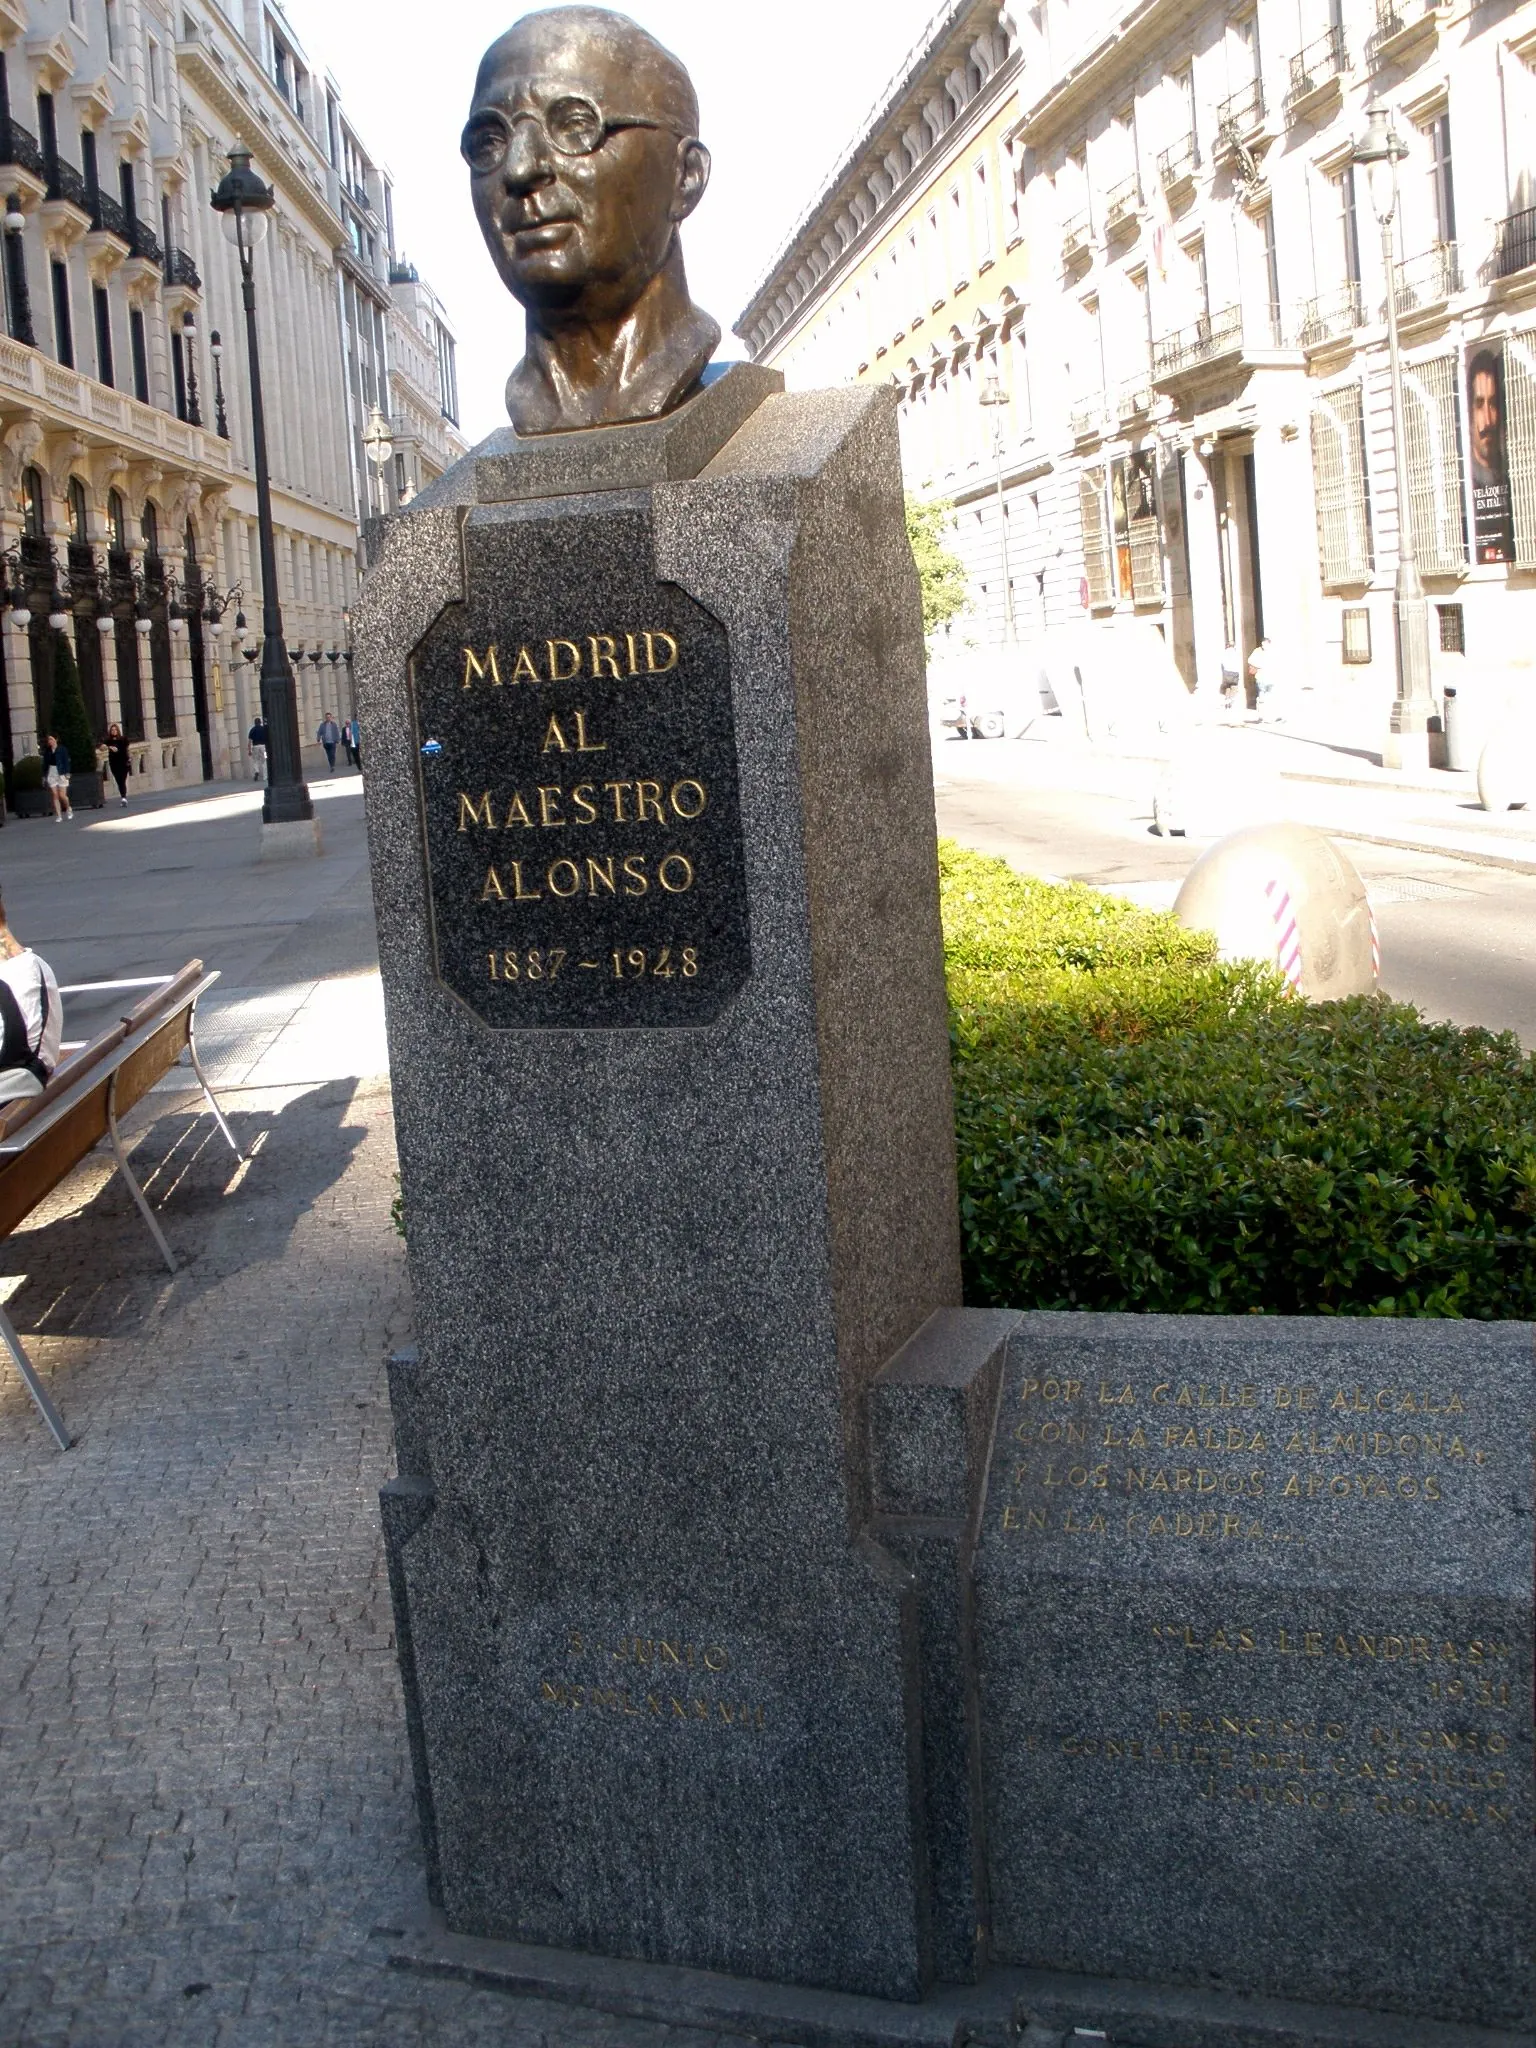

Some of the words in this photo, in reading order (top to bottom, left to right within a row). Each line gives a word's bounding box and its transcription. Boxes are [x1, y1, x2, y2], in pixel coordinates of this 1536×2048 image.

[462, 629, 680, 688] MADRID
[542, 711, 606, 753] AL
[457, 780, 707, 832] MAESTRO
[481, 855, 693, 901] ALONSO
[488, 949, 566, 981] 1887
[613, 947, 699, 979] 1948
[1022, 1377, 1083, 1402] POR
[1100, 1381, 1136, 1405] LA
[1152, 1382, 1259, 1409] CALLE
[1274, 1386, 1318, 1410] DE
[1331, 1385, 1466, 1414] ALCALA
[1013, 1421, 1088, 1445] CON
[1103, 1423, 1149, 1449] LA
[1165, 1426, 1268, 1451] FALDA
[1014, 1462, 1029, 1488] Y
[1043, 1464, 1110, 1488] LOS
[1127, 1467, 1266, 1496] NARDOS
[1283, 1473, 1443, 1501] APOYAOS
[1003, 1506, 1048, 1531] EN
[1064, 1509, 1106, 1534] LA
[612, 1637, 728, 1671] JUNIO
[1158, 1710, 1344, 1742] FRANCISCO
[1370, 1727, 1506, 1756] ALONSO
[1250, 1751, 1316, 1773] DEL
[1333, 1756, 1508, 1789] CASTILLO
